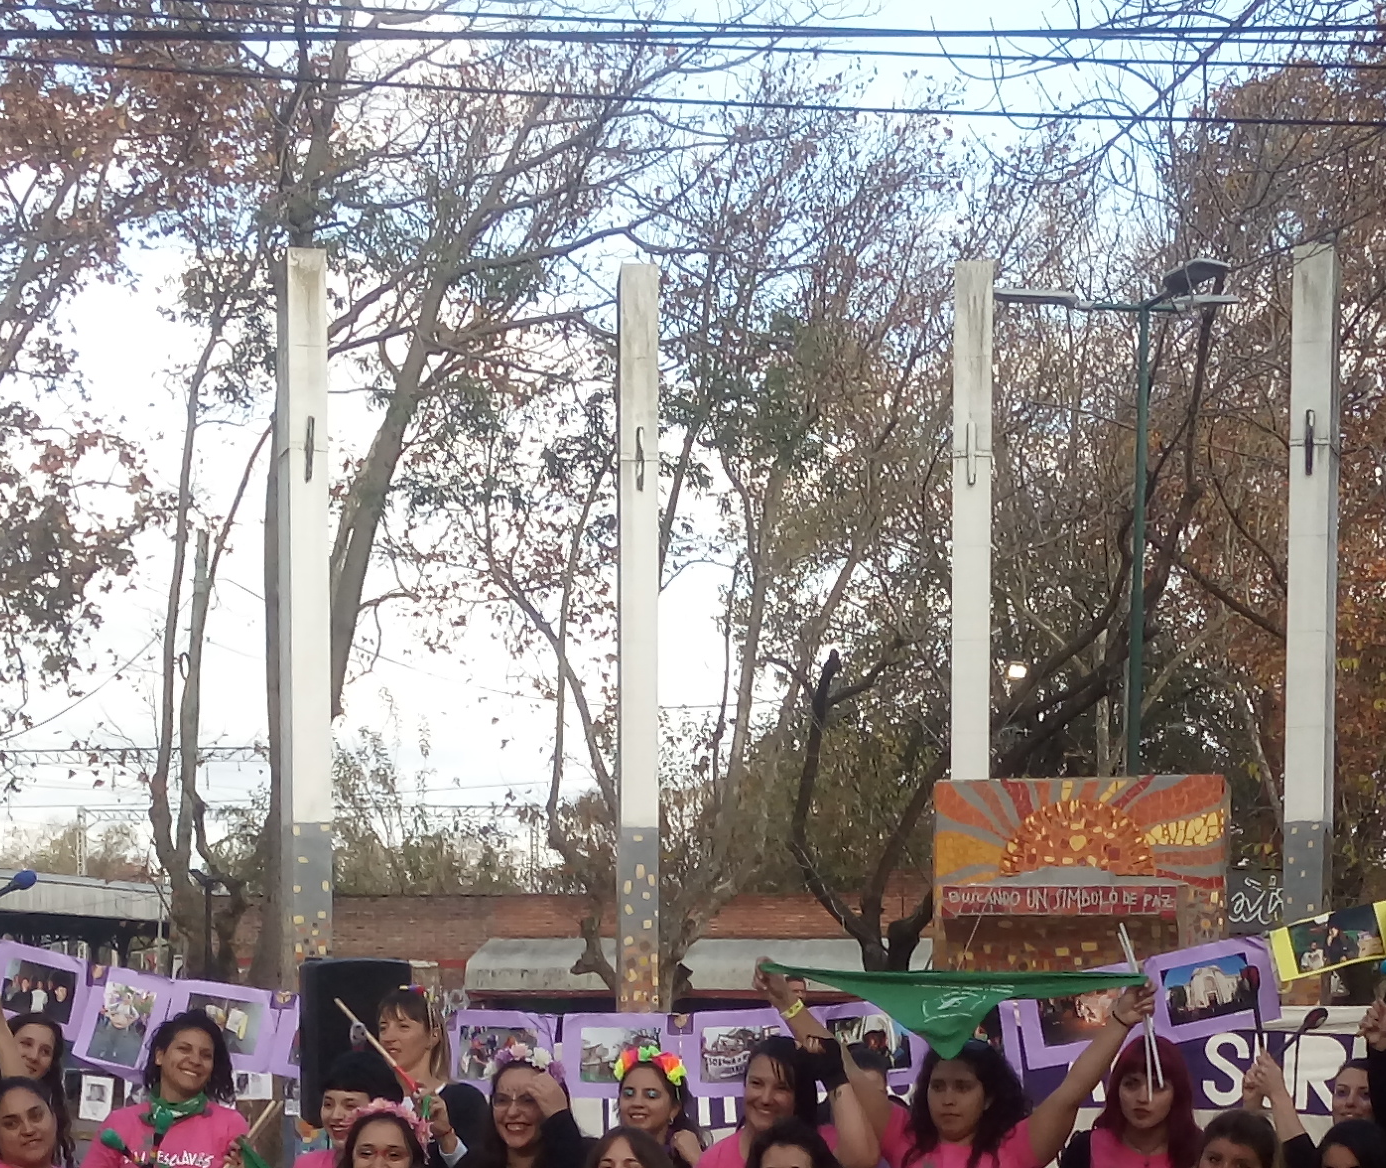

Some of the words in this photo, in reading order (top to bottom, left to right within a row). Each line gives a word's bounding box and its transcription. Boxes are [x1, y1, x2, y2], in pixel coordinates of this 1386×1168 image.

[1026, 888, 1048, 910] UN
[1123, 892, 1137, 907] DE
[1143, 893, 1173, 909] PAZ
